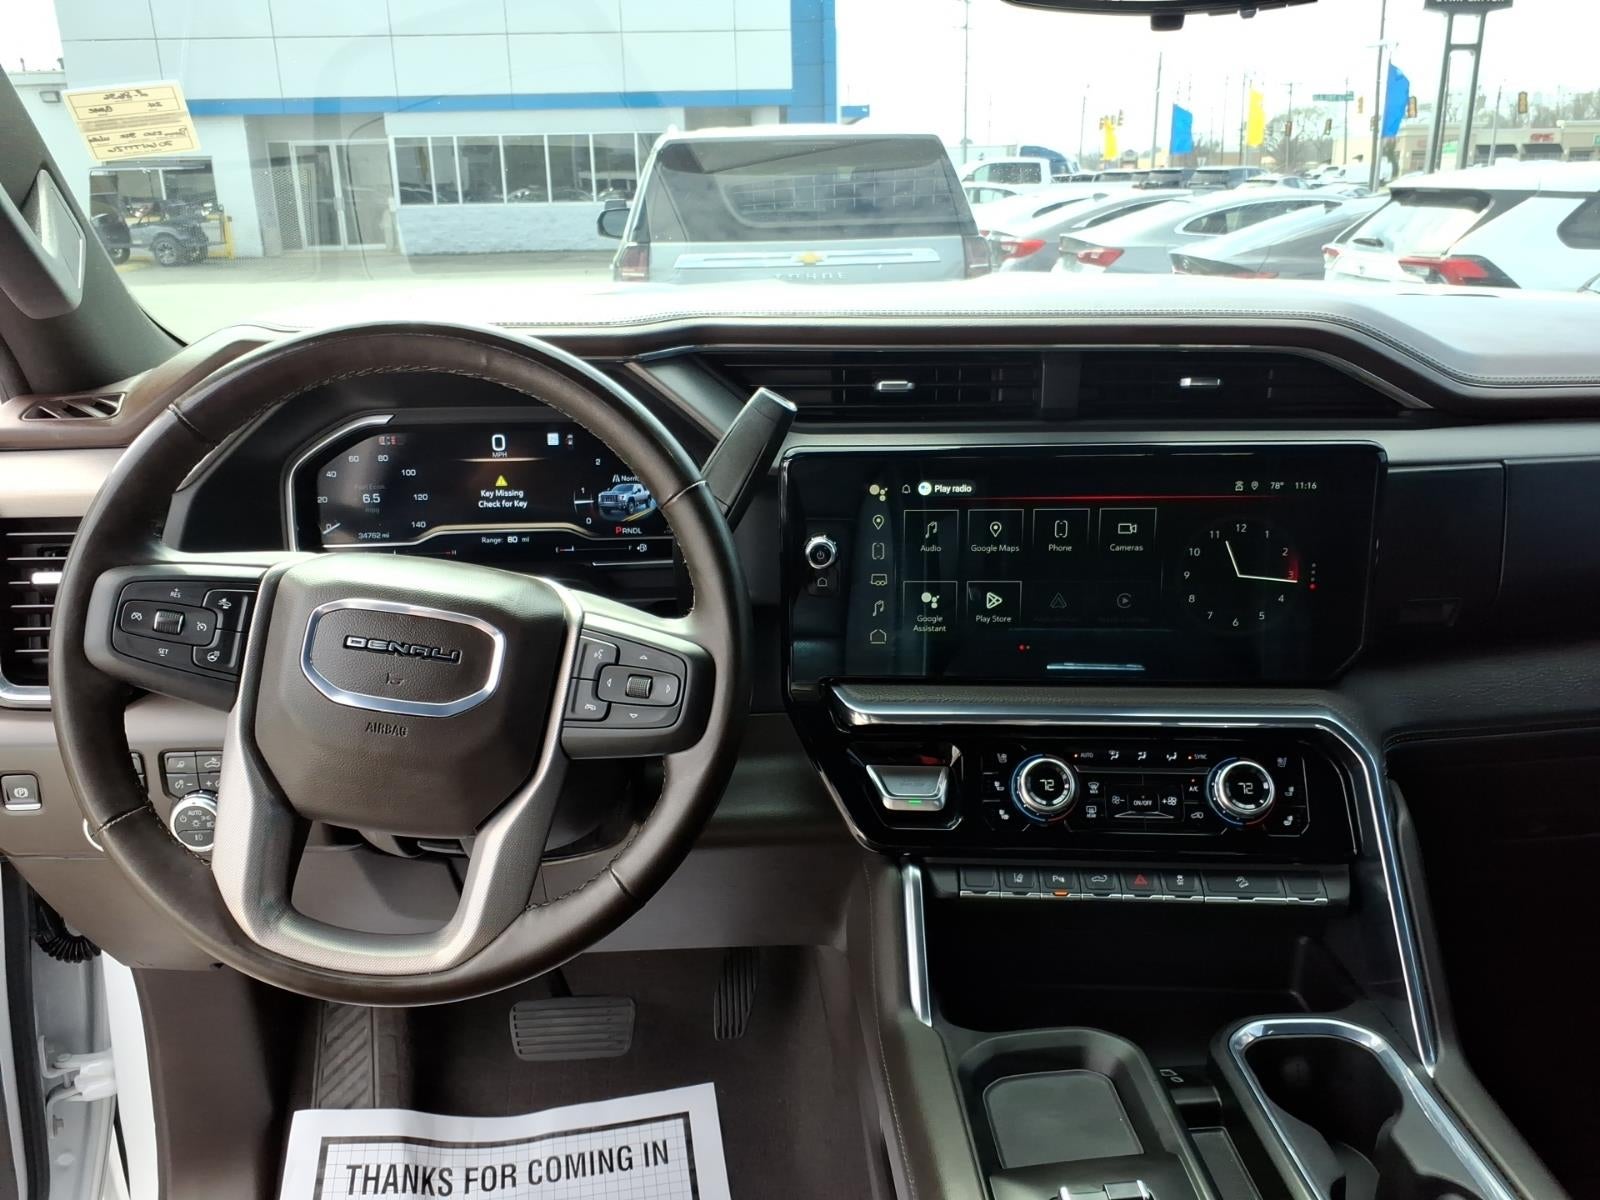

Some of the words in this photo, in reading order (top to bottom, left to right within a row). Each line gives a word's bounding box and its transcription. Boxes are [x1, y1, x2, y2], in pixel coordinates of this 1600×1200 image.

[491, 434, 506, 451] 0
[934, 484, 951, 494] Play
[952, 484, 972, 493] radio
[1295, 482, 1317, 490] 11:16
[362, 494, 380, 503] 6.5
[480, 490, 494, 498] Key
[496, 490, 524, 498] Missing
[514, 500, 528, 508] Key
[1236, 524, 1247, 532] 12
[1210, 530, 1220, 538] 11
[1265, 530, 1270, 538] 1
[970, 544, 998, 554] Google
[999, 544, 1020, 553] Maps
[1048, 544, 1072, 552] Phone
[1189, 548, 1200, 556] 10
[1282, 548, 1288, 556] 2
[1184, 571, 1190, 580] 9
[1189, 594, 1195, 603] 8
[917, 615, 943, 624] Google
[975, 615, 990, 624] Play
[1259, 612, 1265, 620] 5
[1232, 618, 1239, 626] 6
[913, 624, 946, 632] Assistant
[344, 635, 461, 662] DENALI
[366, 722, 408, 737] AIRBAG
[1040, 779, 1054, 791] 72
[1238, 782, 1254, 794] 72
[346, 1164, 453, 1197] THANKS
[464, 1163, 517, 1195] FOR
[528, 1145, 633, 1185] COMING
[644, 1139, 669, 1168] IN
